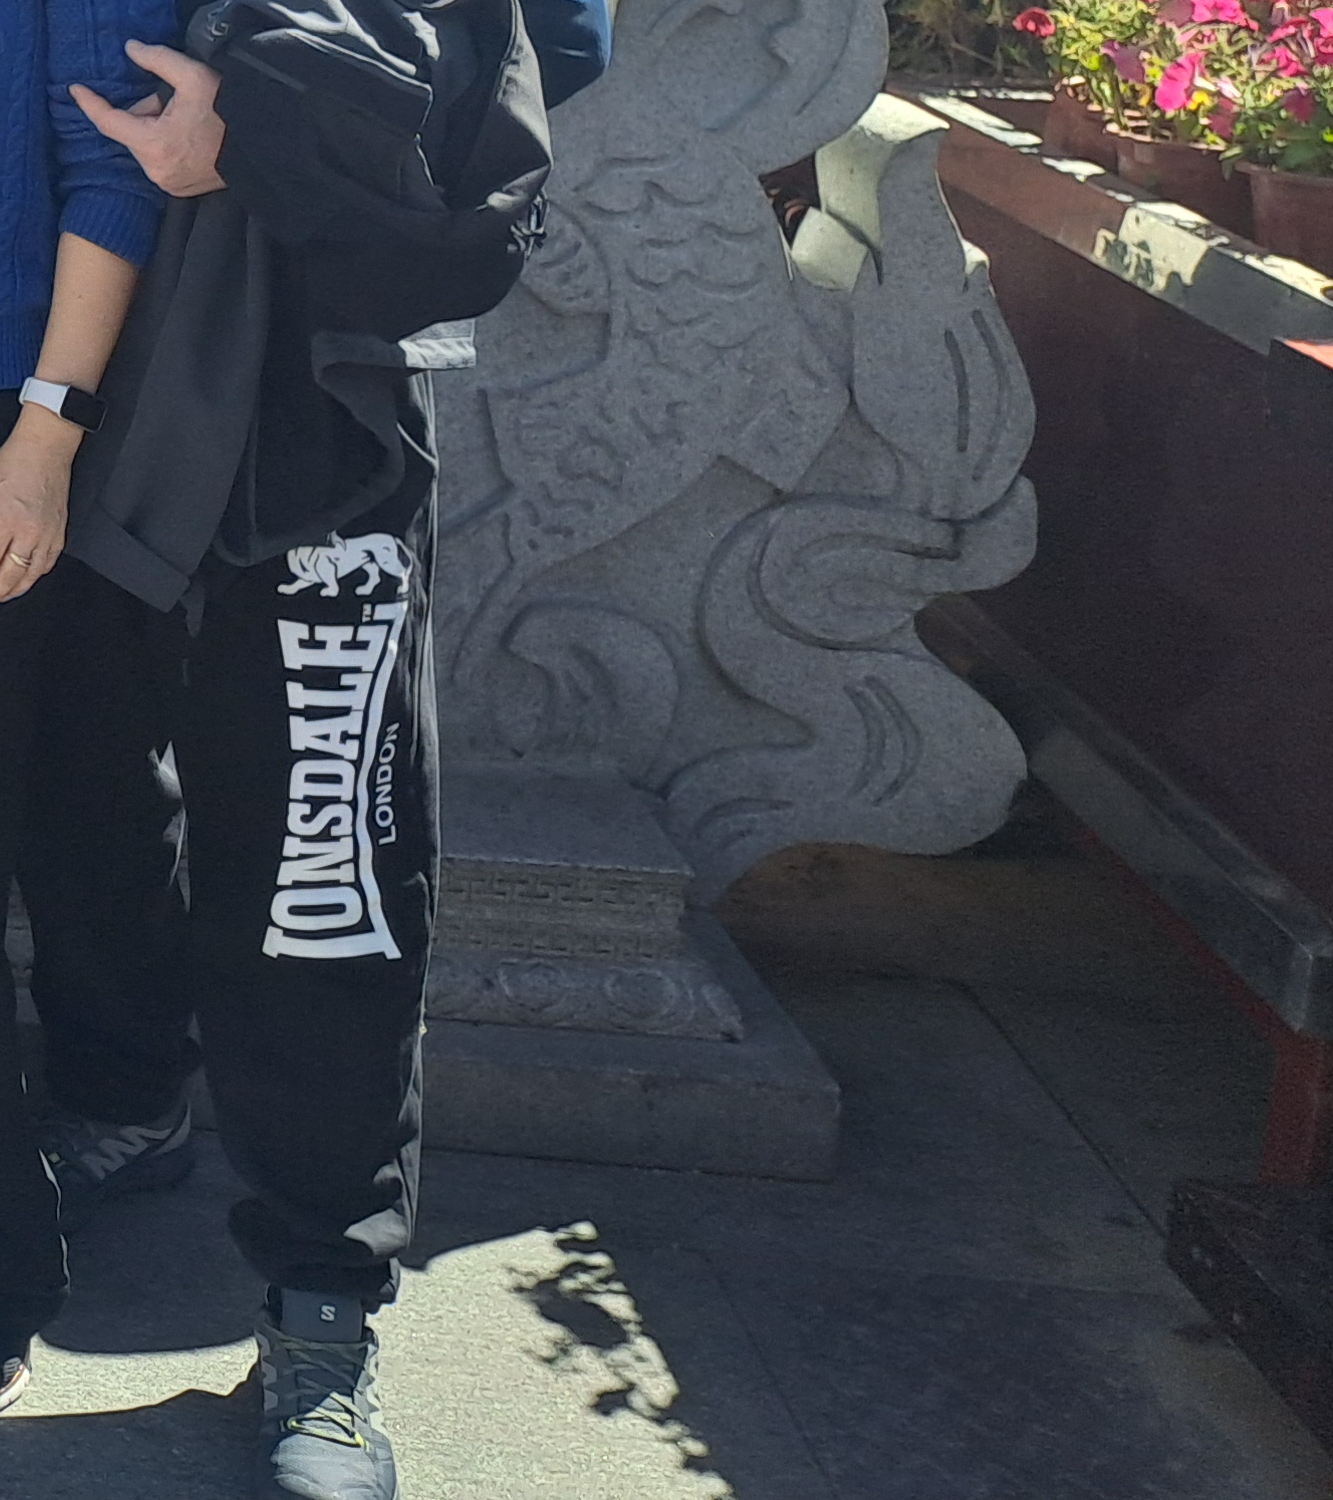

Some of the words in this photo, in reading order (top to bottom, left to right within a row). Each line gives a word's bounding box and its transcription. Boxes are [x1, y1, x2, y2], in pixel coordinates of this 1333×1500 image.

[262, 601, 407, 960] LONSDALE
[376, 722, 400, 845] LONDON
[320, 1304, 336, 1322] S
